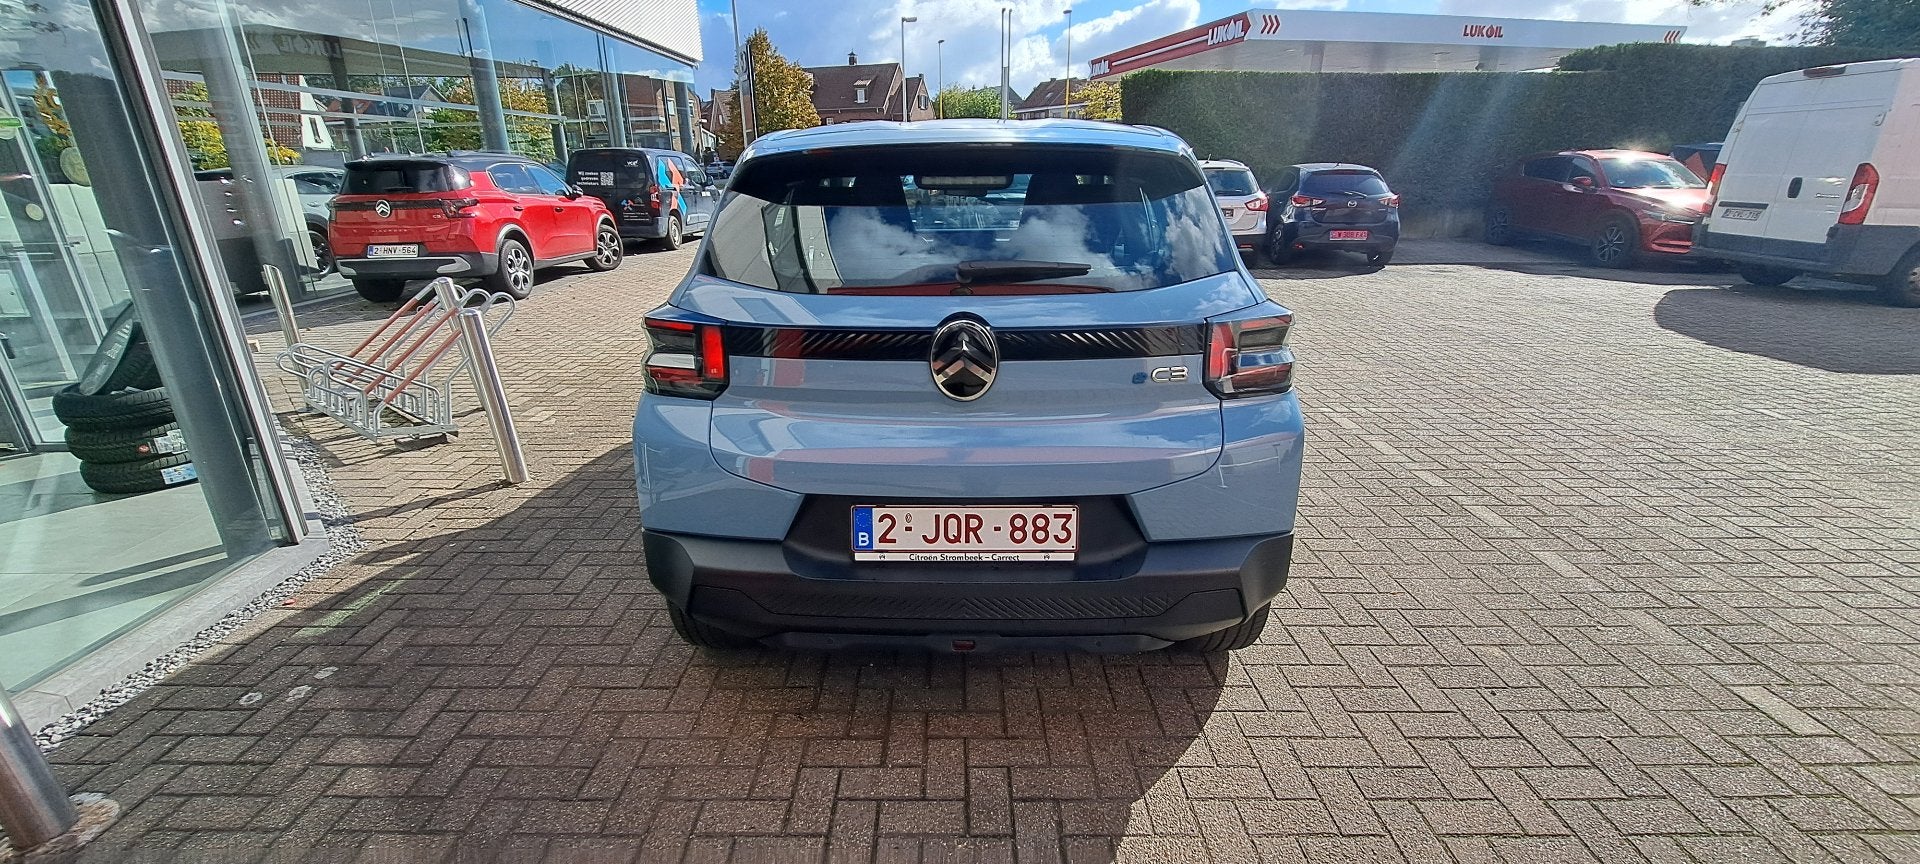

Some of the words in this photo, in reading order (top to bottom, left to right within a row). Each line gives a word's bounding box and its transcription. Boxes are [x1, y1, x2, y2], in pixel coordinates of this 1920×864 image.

[1207, 18, 1245, 46] LUKOIL
[1463, 24, 1504, 38] LUKOIL
[1151, 366, 1188, 383] C3
[858, 532, 870, 546] B
[940, 552, 983, 561] Strombeek
